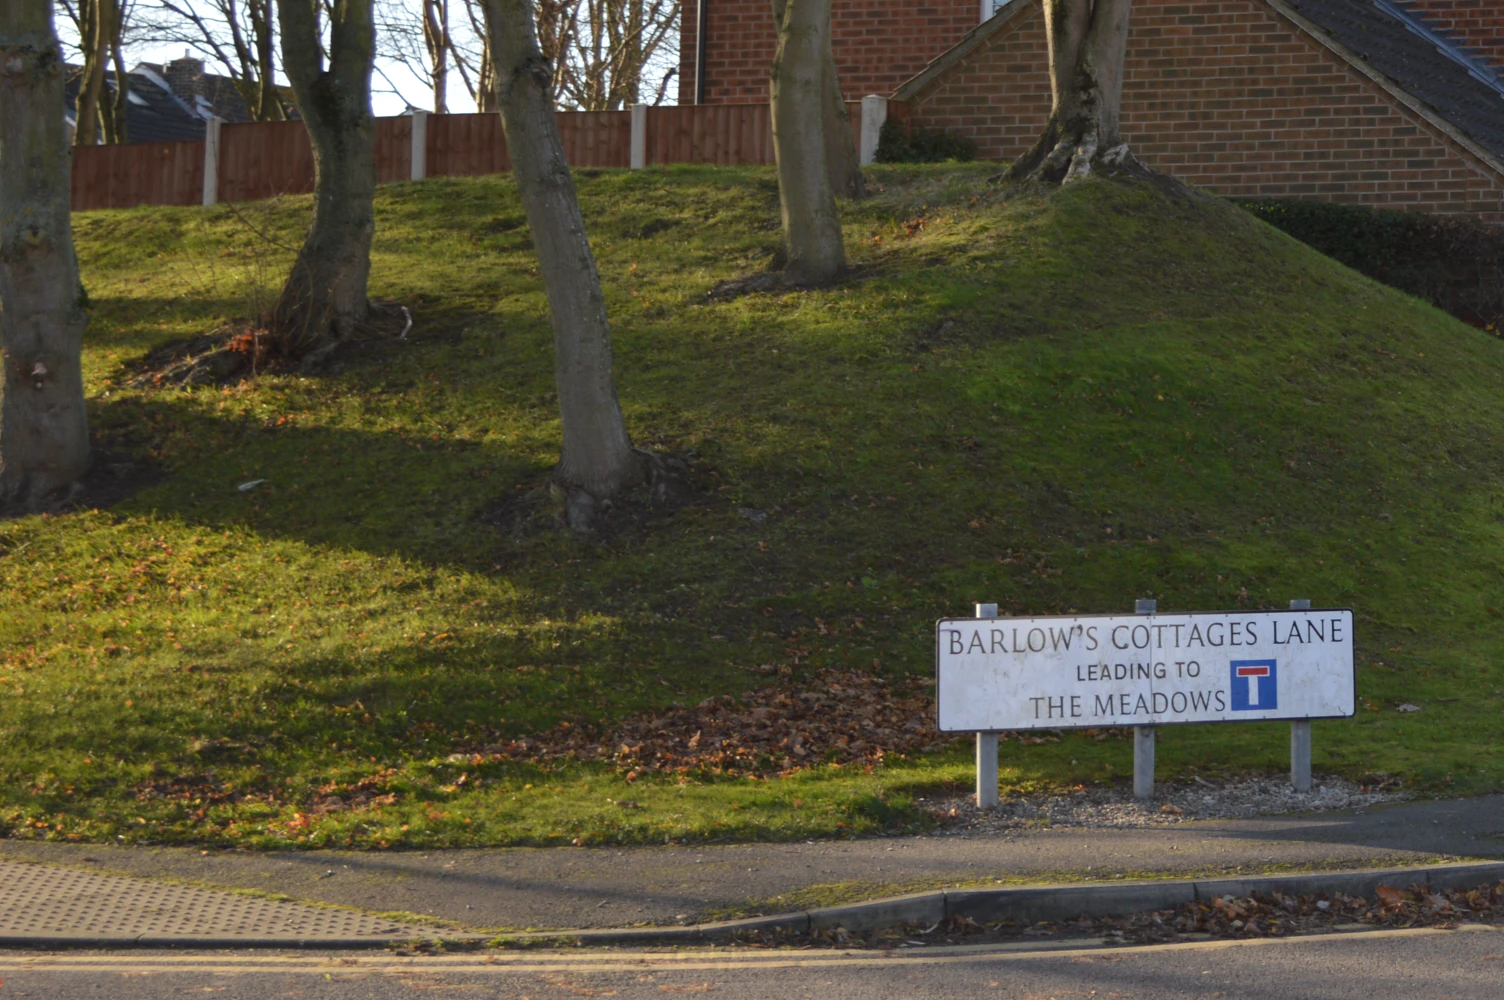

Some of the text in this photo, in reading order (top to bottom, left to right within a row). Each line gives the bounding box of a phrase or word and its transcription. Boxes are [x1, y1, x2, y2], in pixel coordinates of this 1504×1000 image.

[949, 618, 1343, 655] BARLOW'S COTTAGES LANE
[1076, 660, 1201, 681] LEADING TO
[1029, 689, 1226, 719] THE MEADOWS
